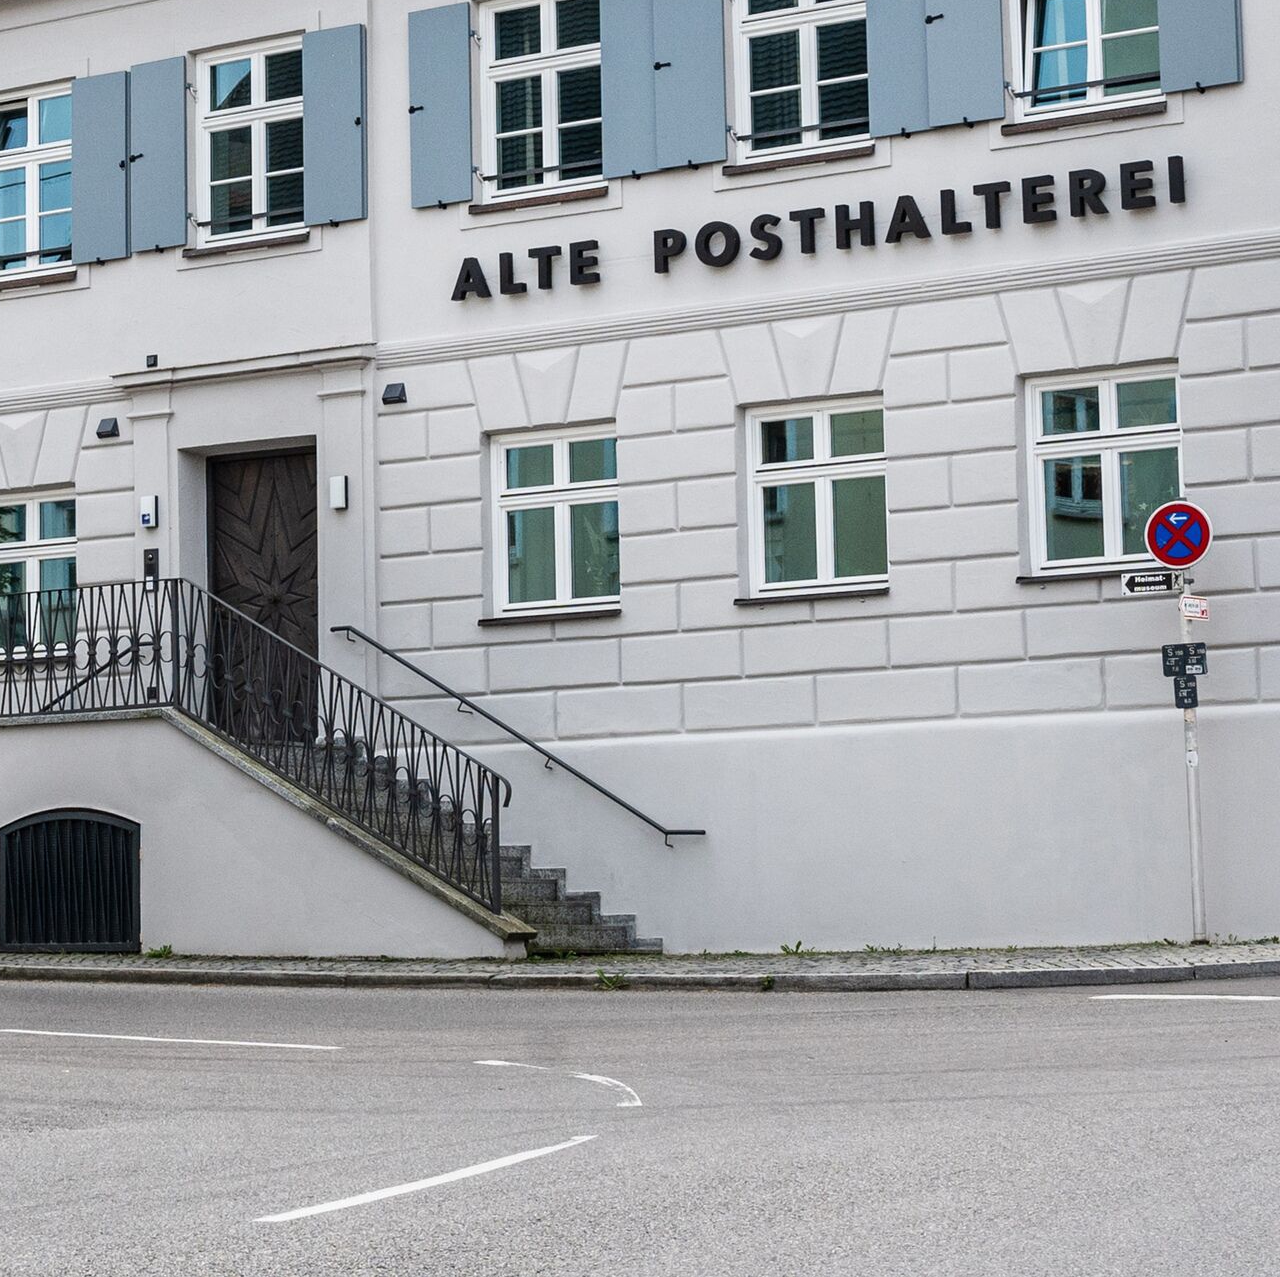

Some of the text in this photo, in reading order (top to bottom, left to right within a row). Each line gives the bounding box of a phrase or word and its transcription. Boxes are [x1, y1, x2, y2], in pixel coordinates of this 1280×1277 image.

[451, 155, 1186, 301] ALTE POSTHALTEREI
[1134, 574, 1166, 583] Heimat-
[1167, 648, 1173, 656] S
[1189, 647, 1195, 655] S
[1179, 680, 1185, 688] S
